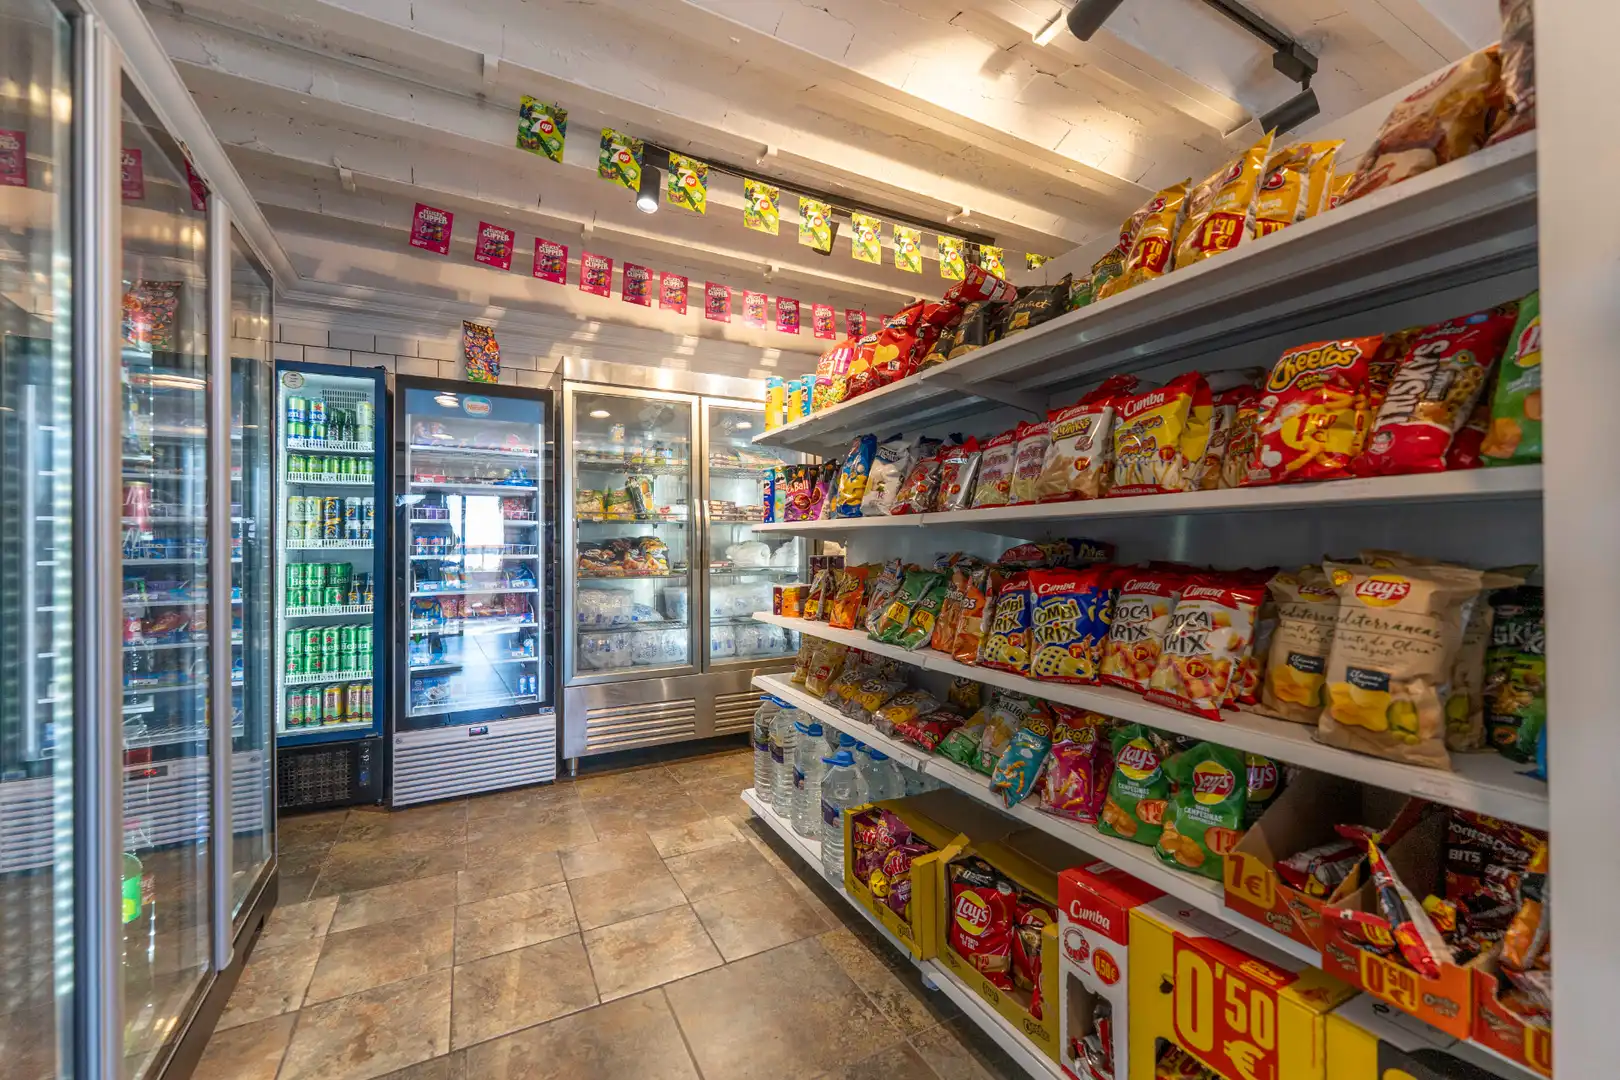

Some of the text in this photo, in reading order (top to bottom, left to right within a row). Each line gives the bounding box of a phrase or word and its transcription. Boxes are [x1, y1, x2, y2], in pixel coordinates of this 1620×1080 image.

[418, 211, 448, 225] CLIPPER
[482, 230, 509, 242] CLIPPER
[1268, 342, 1359, 391] Cheetos
[1124, 392, 1165, 417] Cumba
[1038, 581, 1077, 594] Cumba
[1123, 579, 1162, 593] Cumba
[1182, 585, 1226, 599] Cumba
[1168, 611, 1210, 629] BOCA
[1449, 848, 1482, 863] BITS
[956, 897, 989, 926] Lay's
[1069, 899, 1111, 931] Cumba
[1176, 949, 1275, 1051] 0'50
